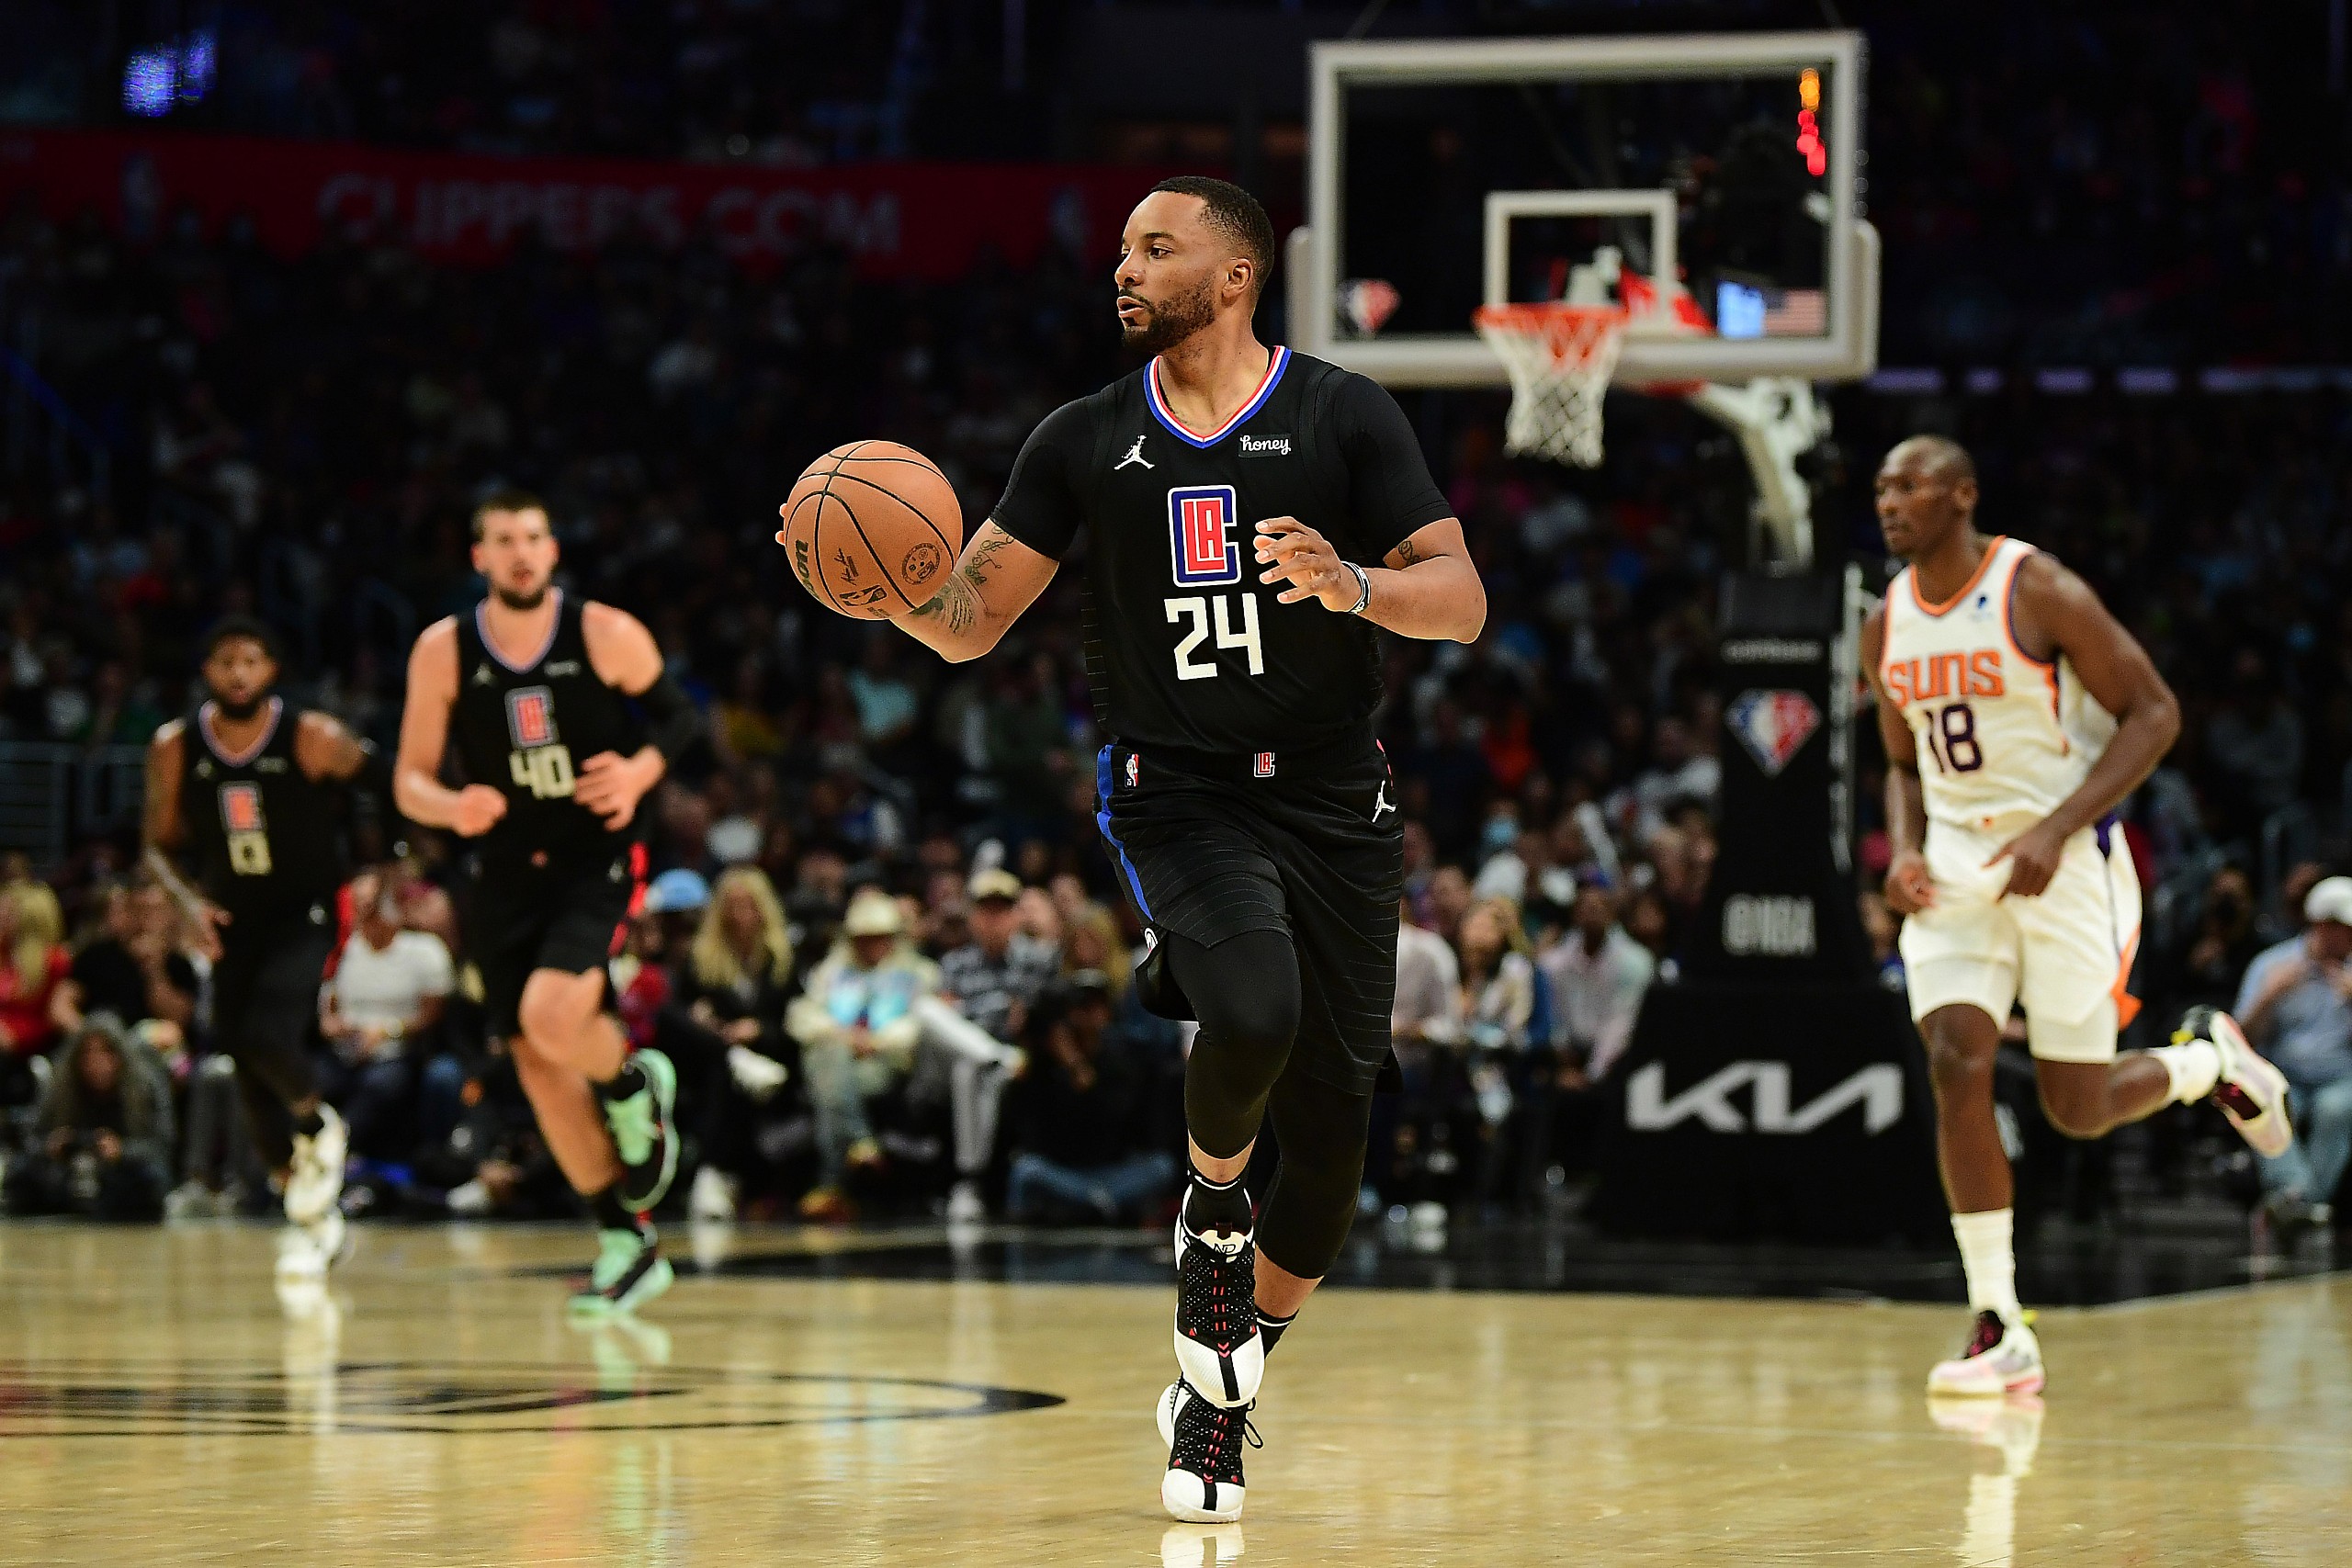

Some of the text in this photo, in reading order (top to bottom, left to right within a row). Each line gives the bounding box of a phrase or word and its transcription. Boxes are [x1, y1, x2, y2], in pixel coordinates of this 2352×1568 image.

[1239, 434, 1292, 456] honey
[1163, 592, 1265, 681] 24
[508, 742, 578, 801] 40
[1923, 702, 1984, 773] 18
[1625, 1058, 1905, 1135] KIA
